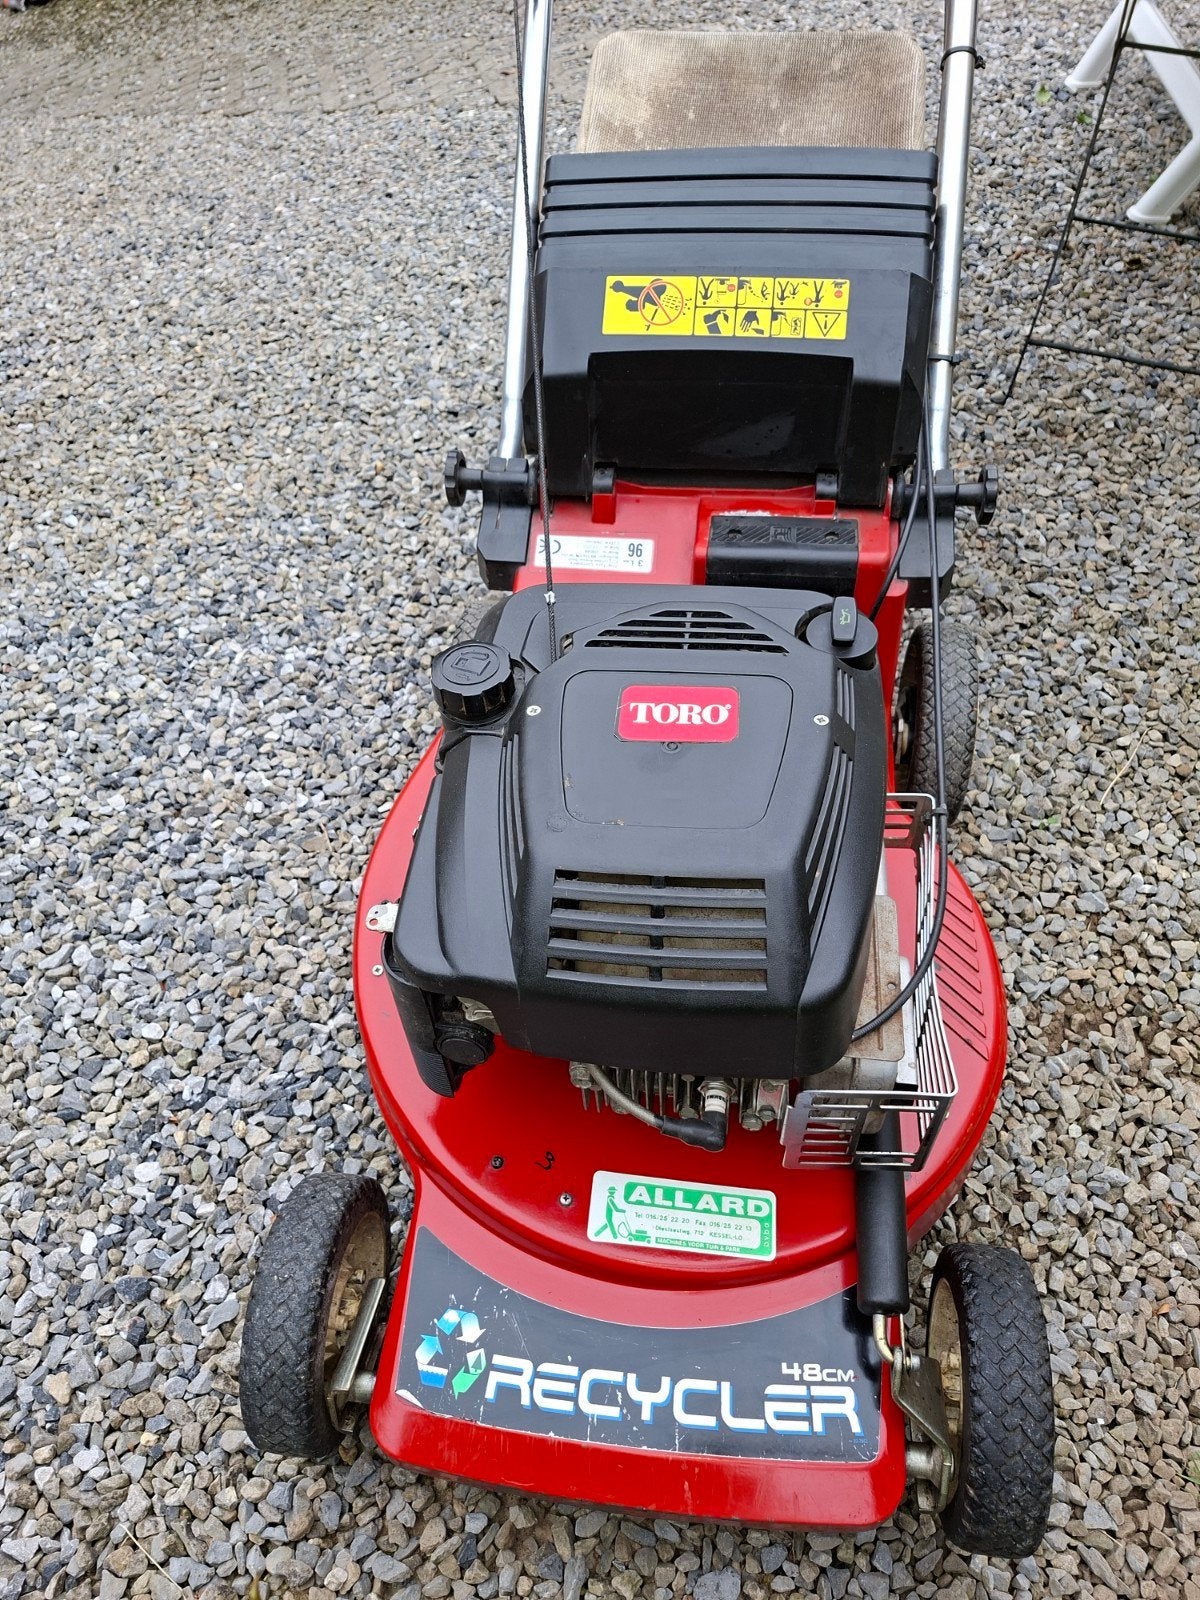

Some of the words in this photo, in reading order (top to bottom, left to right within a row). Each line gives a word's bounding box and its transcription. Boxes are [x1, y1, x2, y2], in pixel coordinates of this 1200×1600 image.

[627, 543, 643, 558] 96
[627, 1185, 770, 1218] ALLARD
[671, 1215, 679, 1223] 22
[681, 1216, 690, 1224] 20
[695, 1218, 706, 1226] Fax
[734, 1223, 743, 1231] 22
[657, 1236, 686, 1246] MACHINES
[688, 1240, 705, 1249] VOOR
[705, 1242, 719, 1251] TUIN
[725, 1244, 741, 1253] PARK
[485, 1354, 863, 1436] RECYCLER
